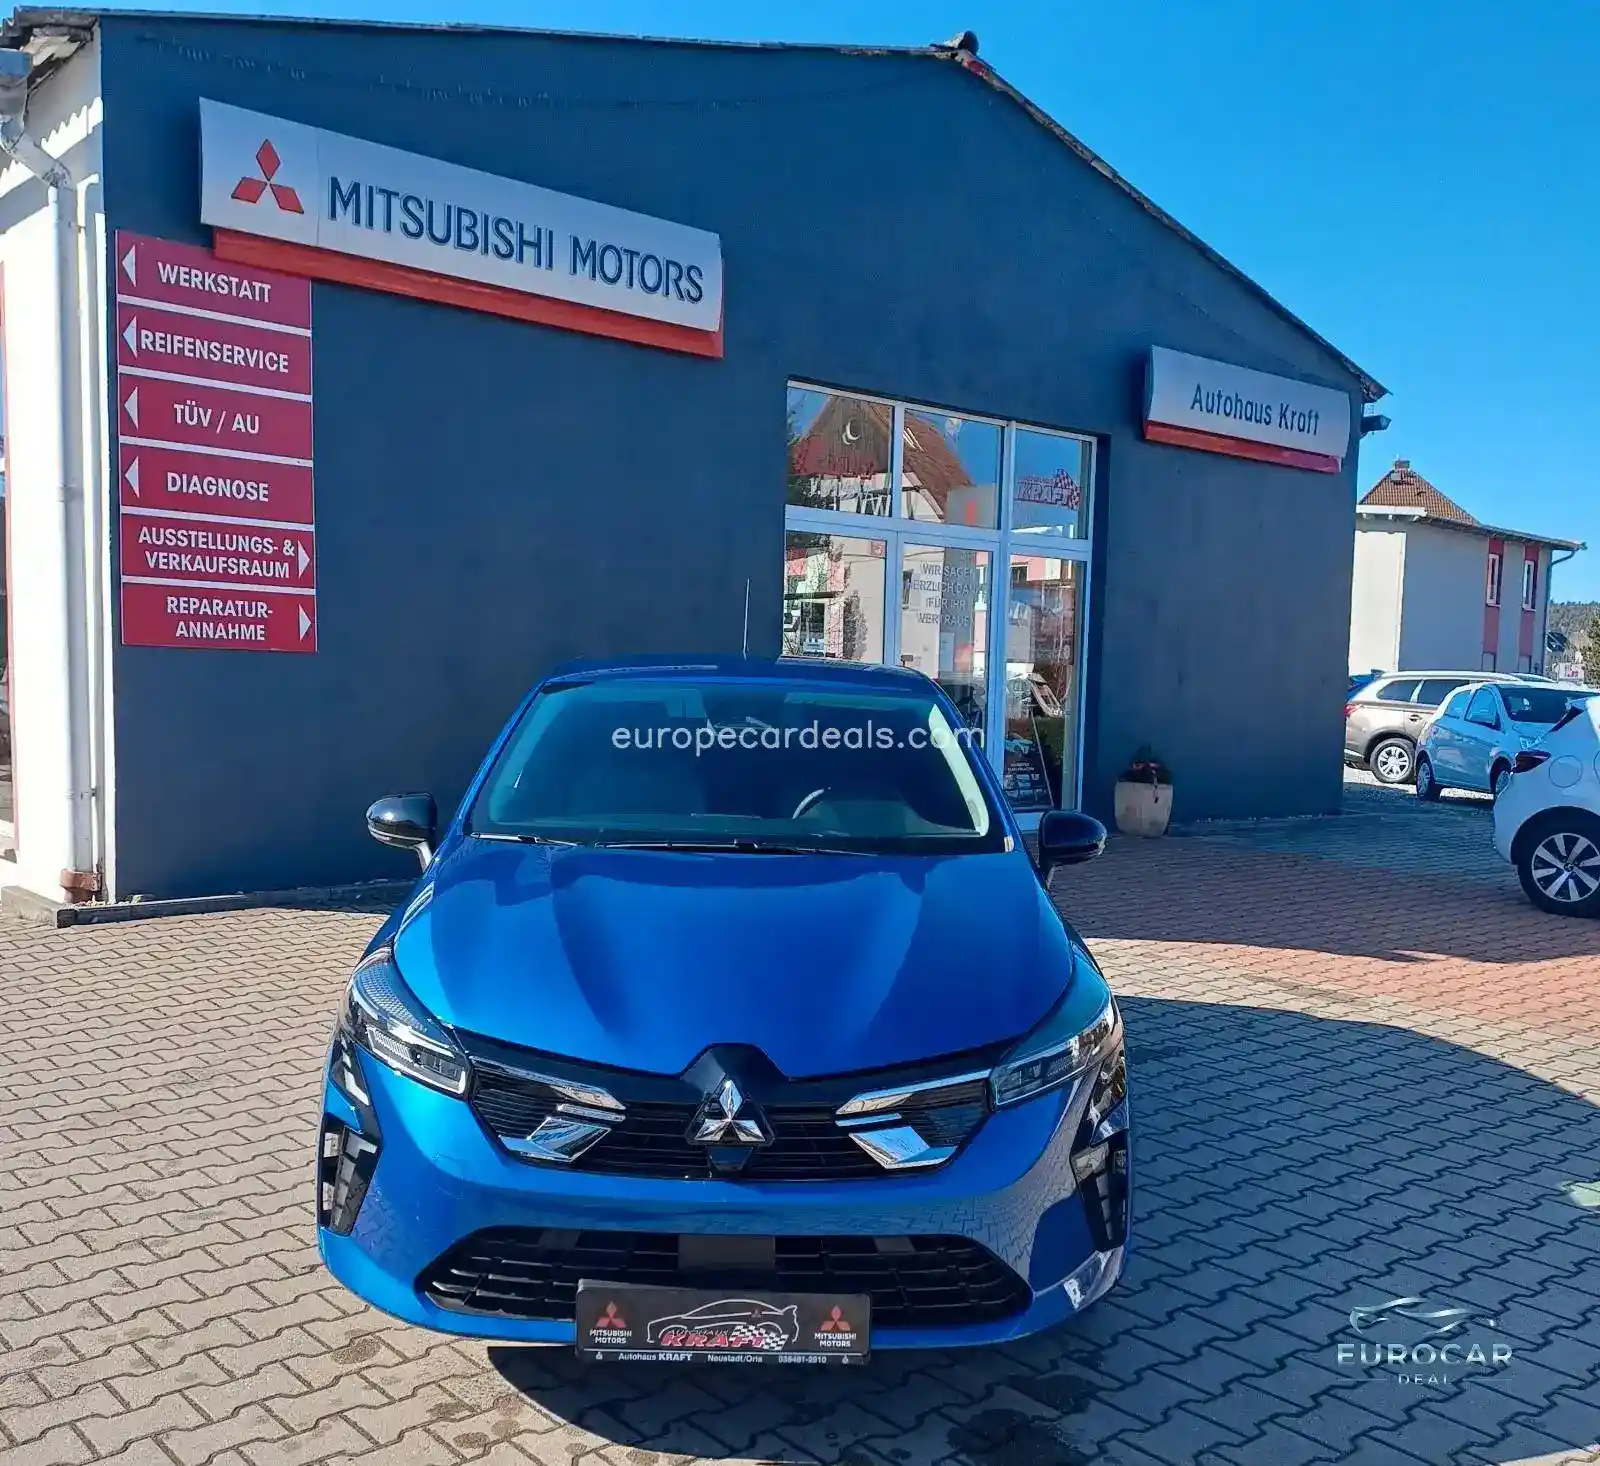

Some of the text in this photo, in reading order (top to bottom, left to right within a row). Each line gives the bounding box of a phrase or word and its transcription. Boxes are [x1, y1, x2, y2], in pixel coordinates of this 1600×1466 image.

[327, 176, 704, 304] MITSUBISHI MOTORS
[157, 261, 271, 303] WERKSTATT
[140, 328, 289, 373] REIFENSERVICE
[173, 400, 212, 428] TÜV
[231, 413, 260, 434] AU
[1190, 381, 1320, 436] Autohaus Kraft
[166, 471, 269, 502] DIAGNOSE
[138, 526, 296, 557] AUSSTELLUNGS- &
[145, 551, 290, 579] VERKAUFSRAUM
[167, 596, 273, 619] REPARATUR-
[175, 621, 266, 641] ANNAHME
[814, 1332, 857, 1341] MITSUBISHI
[819, 1340, 851, 1348] MOTORS
[618, 1353, 693, 1361] Autohaus KRAFT
